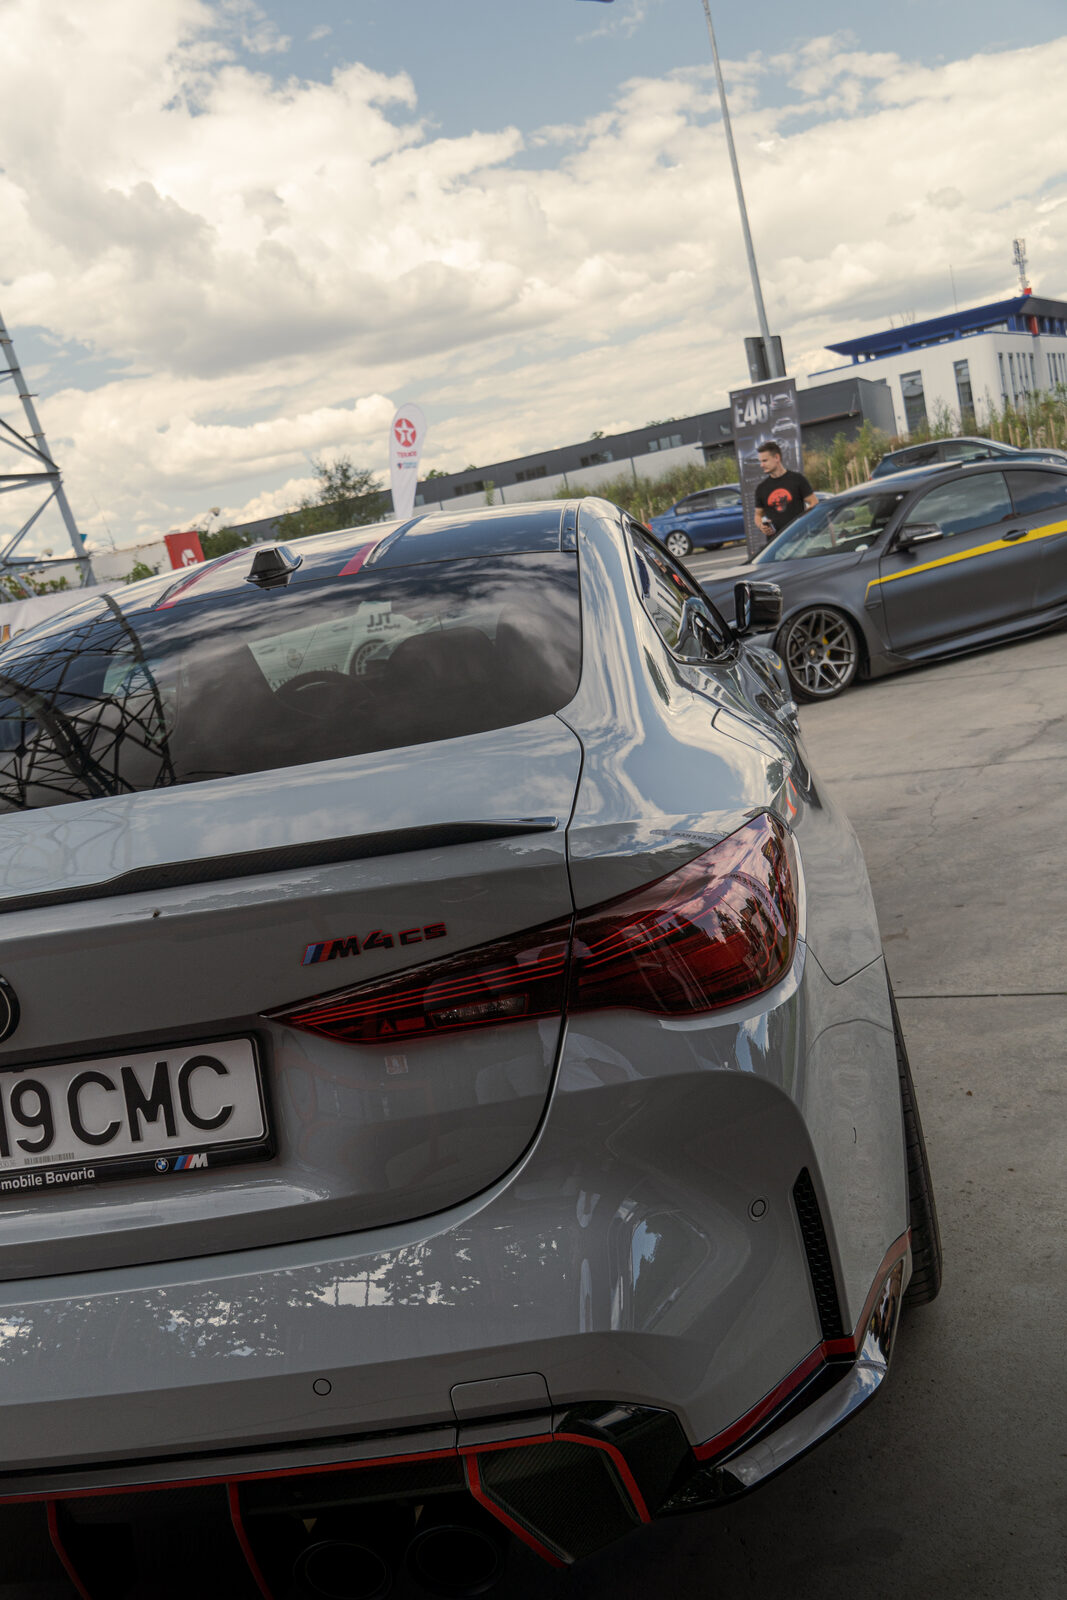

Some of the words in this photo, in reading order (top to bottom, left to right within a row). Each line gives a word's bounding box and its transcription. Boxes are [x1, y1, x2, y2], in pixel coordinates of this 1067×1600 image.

[734, 394, 768, 428] E46
[67, 1055, 233, 1145] CMC
[45, 1167, 95, 1184] Bavaria
